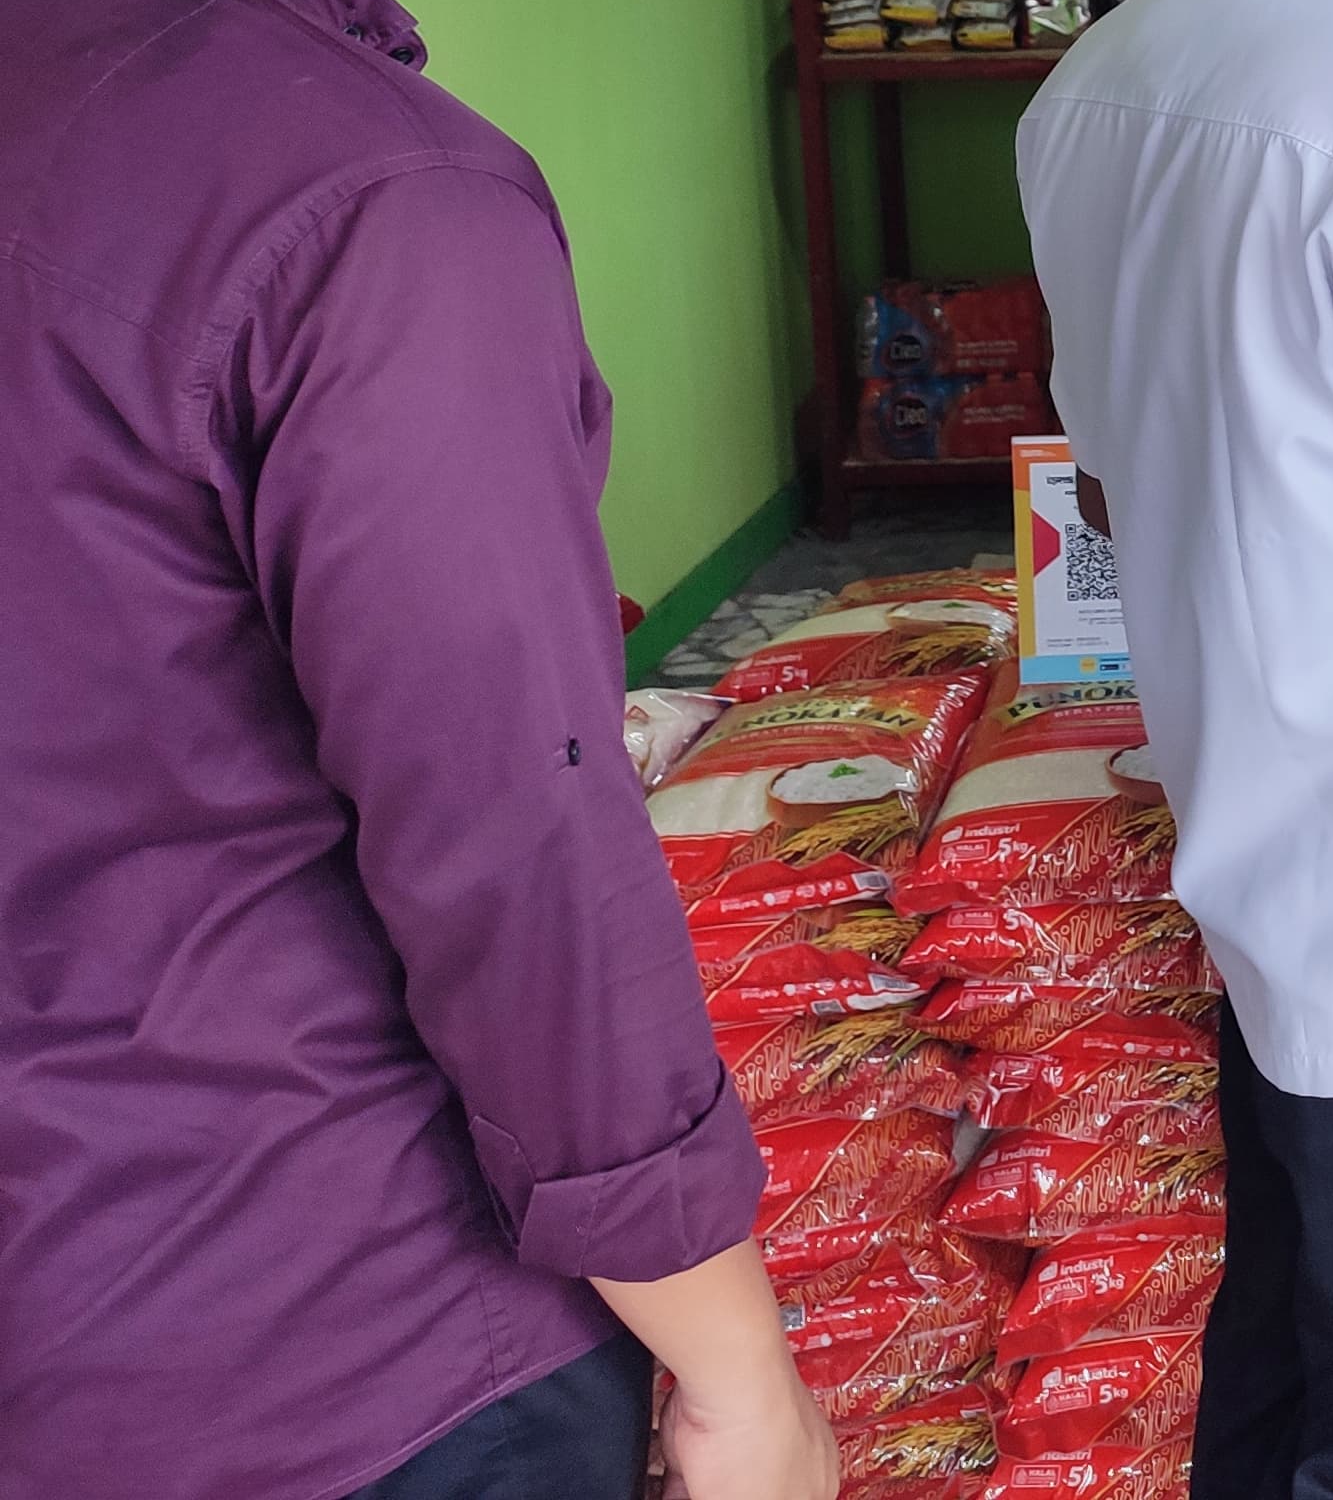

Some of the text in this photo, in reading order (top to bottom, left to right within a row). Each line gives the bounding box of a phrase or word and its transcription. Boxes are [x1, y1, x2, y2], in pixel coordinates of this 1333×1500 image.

[965, 823, 1020, 838] industri
[1060, 1255, 1115, 1276] industri
[1099, 1384, 1129, 1405] 5kg
